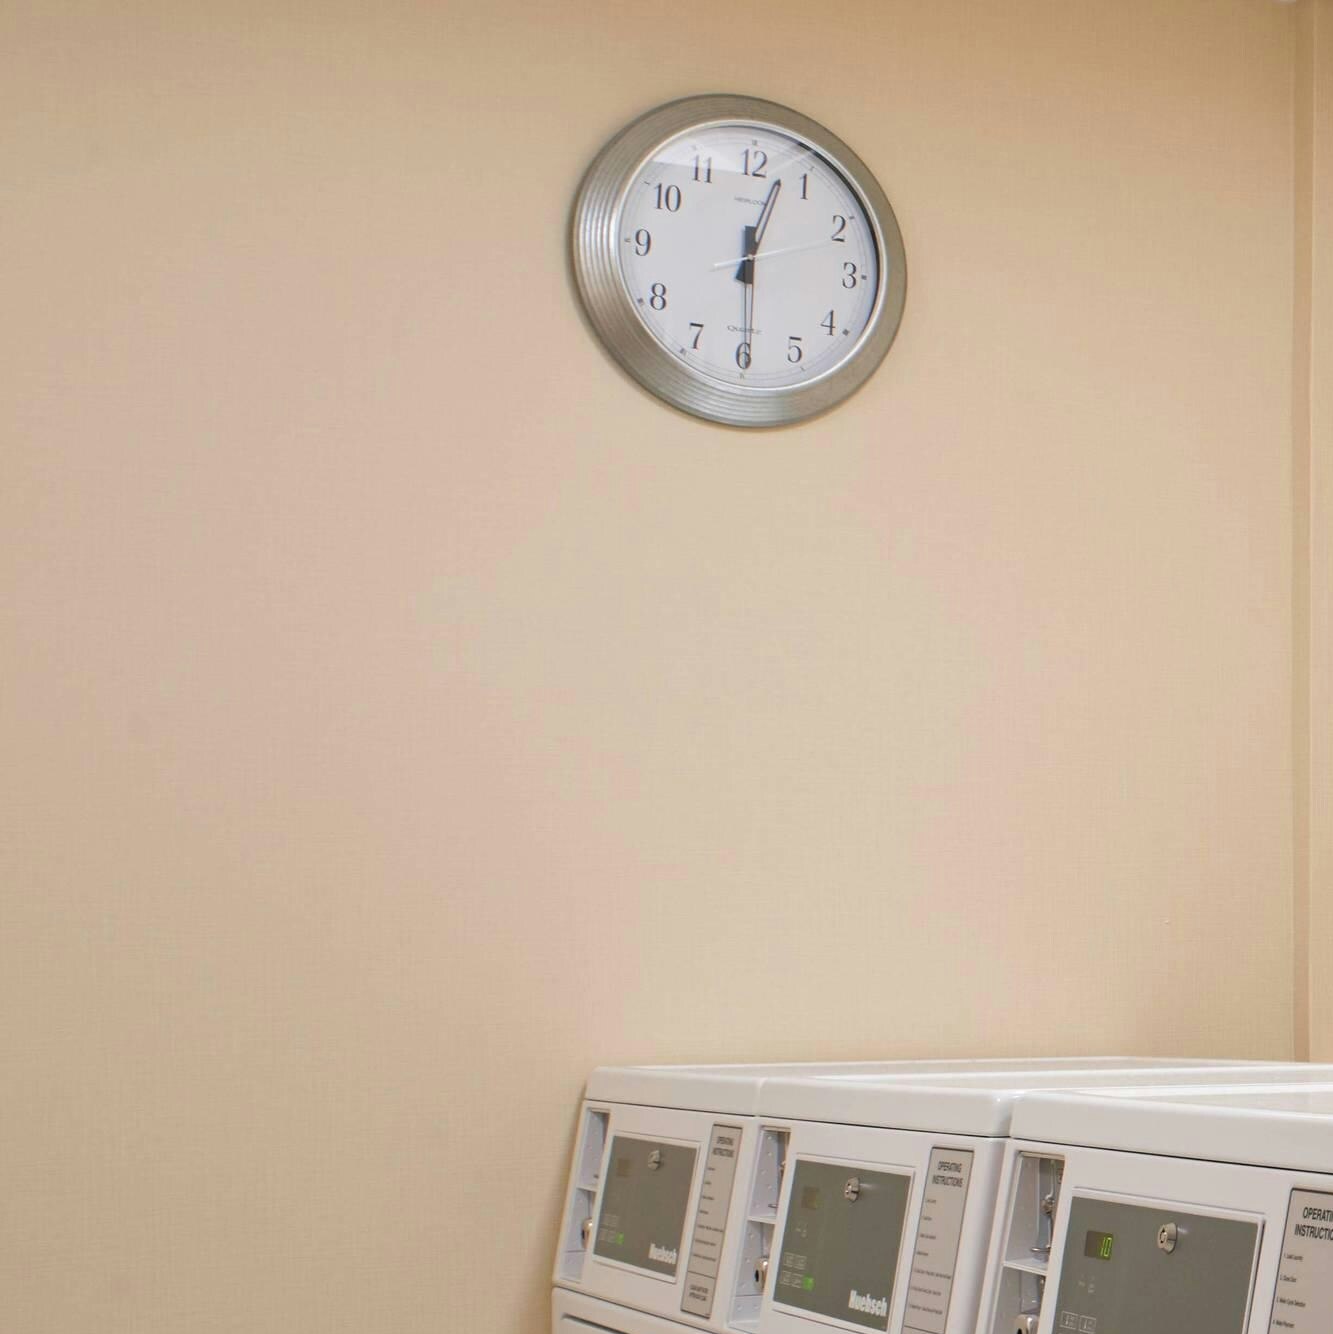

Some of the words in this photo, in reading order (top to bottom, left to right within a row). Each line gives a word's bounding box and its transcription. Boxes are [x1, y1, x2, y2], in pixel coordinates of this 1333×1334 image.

[692, 155, 712, 183] 11
[742, 149, 767, 177] 12
[654, 183, 681, 212] 10
[800, 173, 808, 199] 1
[832, 215, 846, 242] 2
[635, 229, 651, 256] 9
[842, 262, 856, 288] 3
[650, 283, 667, 310] 8
[689, 323, 704, 349] 7
[821, 310, 836, 336] 4
[736, 343, 751, 369] 6
[788, 336, 802, 362] 5
